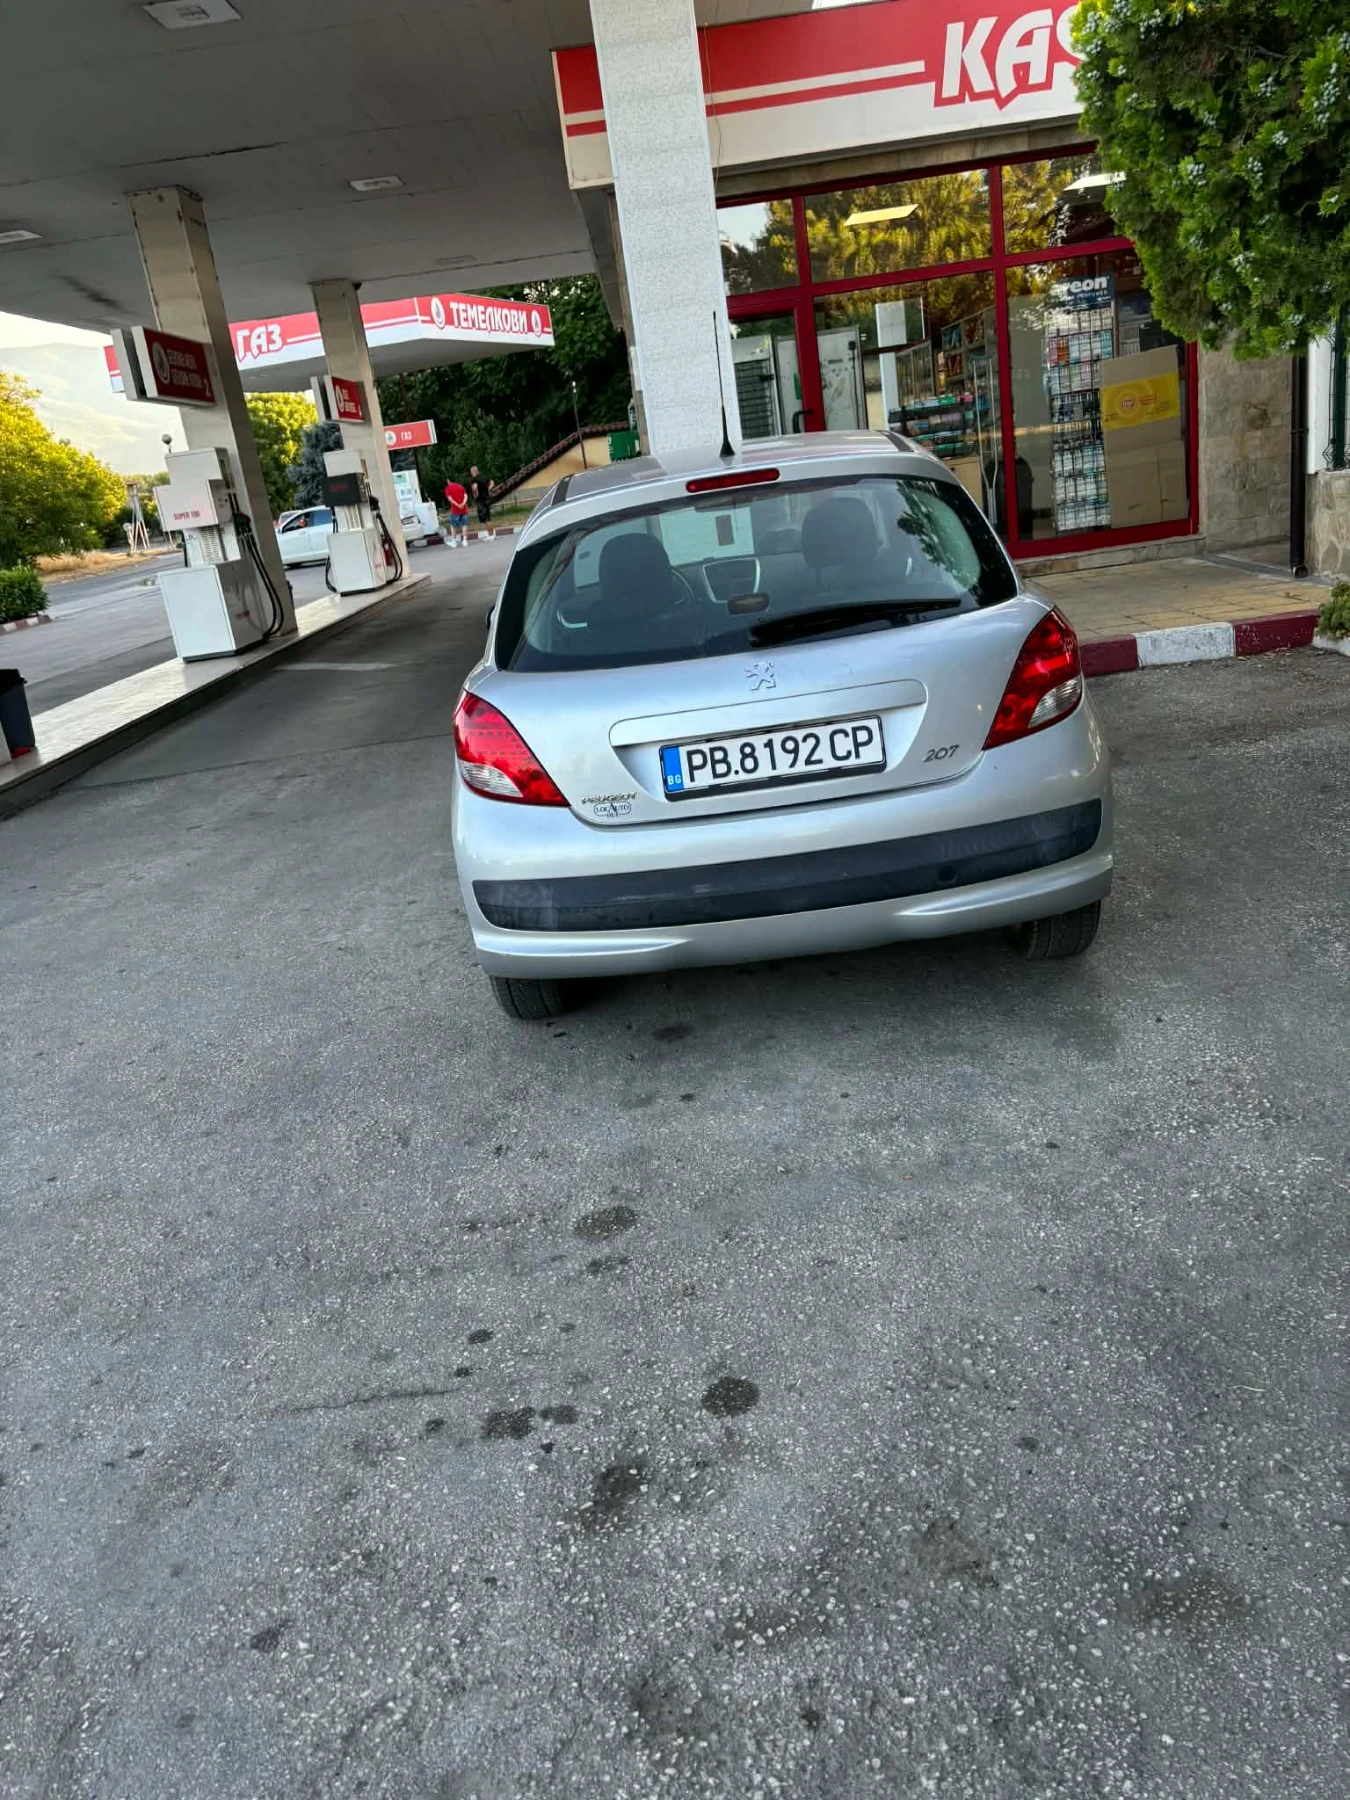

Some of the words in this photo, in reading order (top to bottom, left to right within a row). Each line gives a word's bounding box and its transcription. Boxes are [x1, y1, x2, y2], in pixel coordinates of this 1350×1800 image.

[449, 301, 528, 333] ТЕМЕЛКОВИ
[235, 323, 283, 362] ГАЗ
[828, 725, 873, 761] CP
[922, 744, 960, 763] 207
[667, 774, 682, 786] BG
